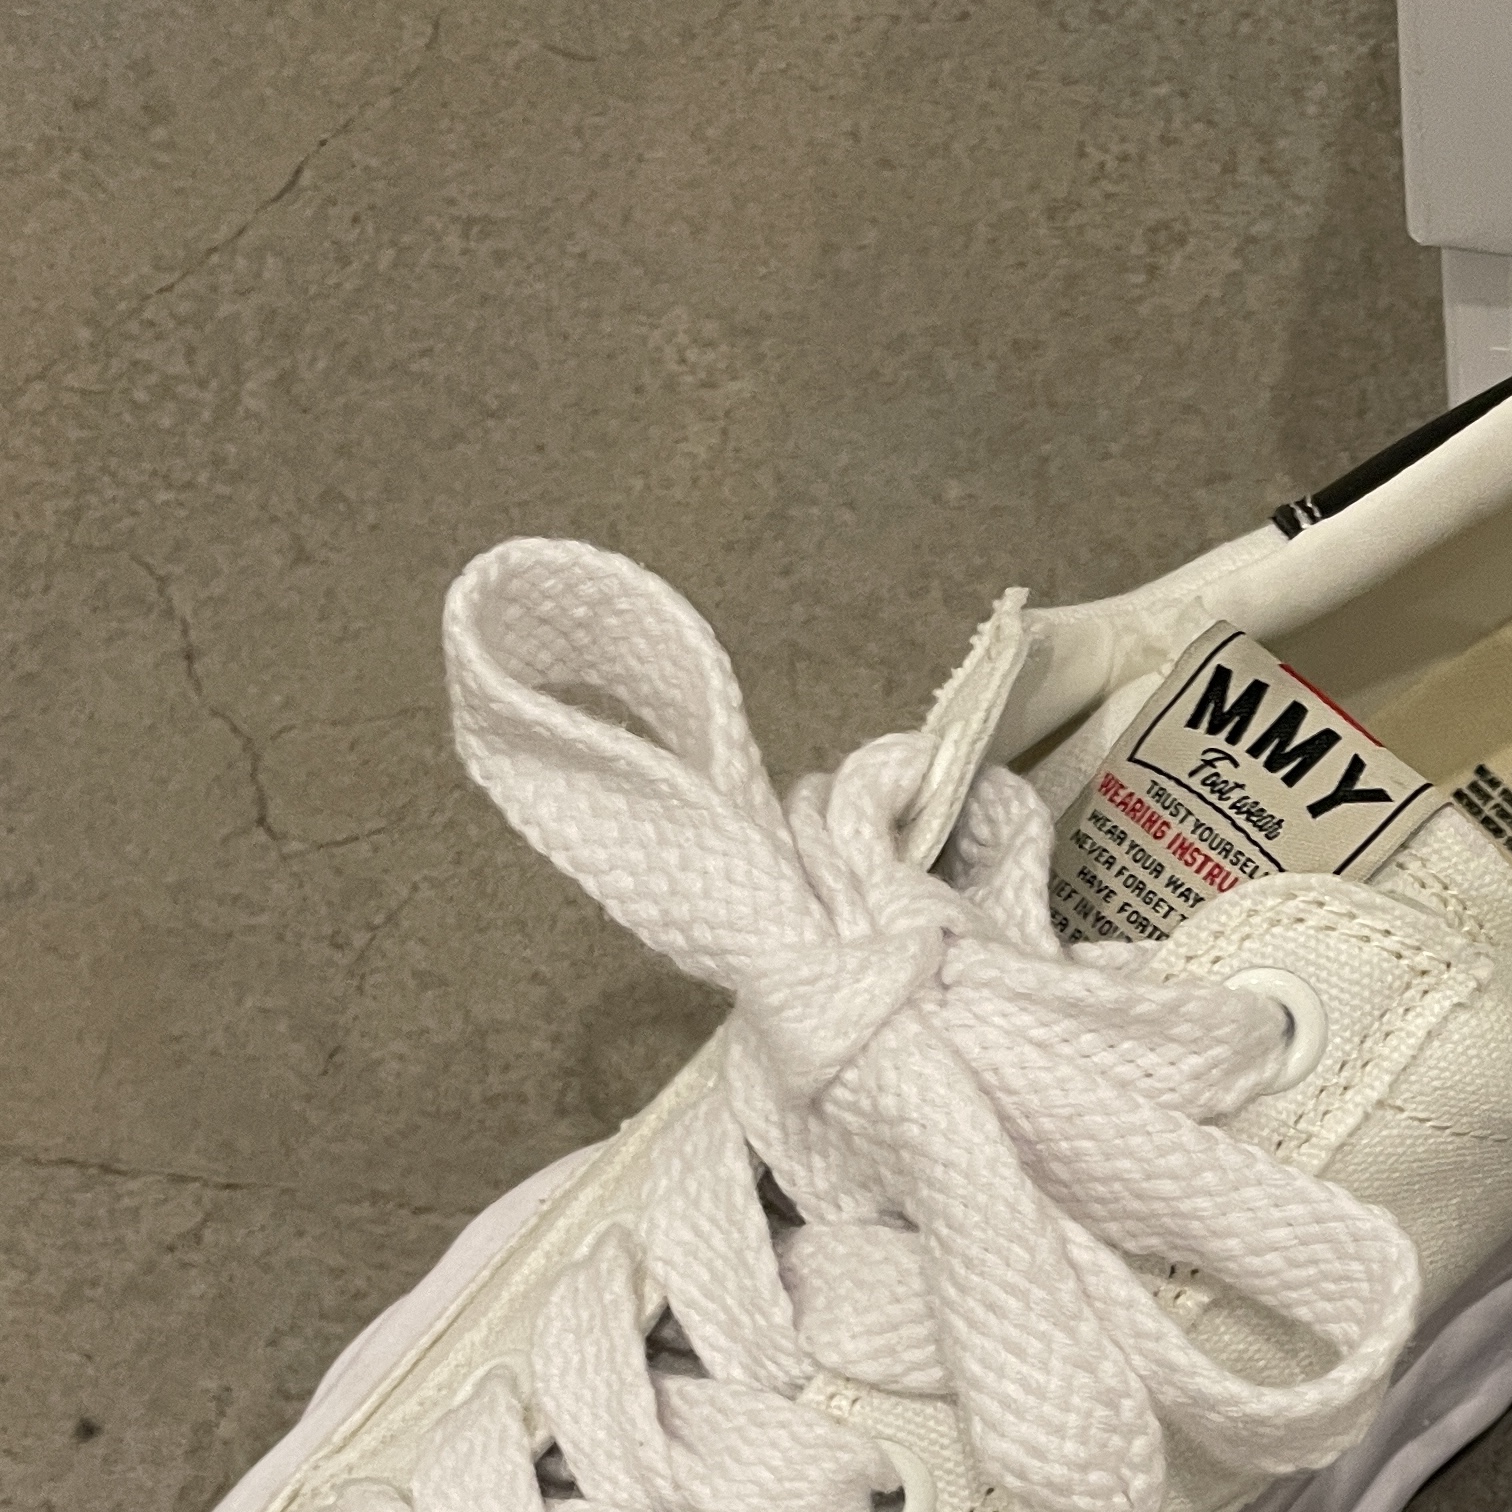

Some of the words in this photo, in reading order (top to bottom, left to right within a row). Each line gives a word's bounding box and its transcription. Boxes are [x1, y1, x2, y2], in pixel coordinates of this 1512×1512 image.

[1183, 663, 1395, 819] MMY
[1069, 828, 1117, 871] NEVER
[1114, 865, 1178, 920] FORGET
[1087, 808, 1129, 847] WEAR
[1124, 839, 1166, 880] YOUR
[1164, 874, 1206, 909] WAY
[1097, 771, 1172, 841] WEARING
[1165, 831, 1240, 894] INSTRU
[1144, 779, 1198, 825] TRUST
[1190, 818, 1270, 880] YOURSEL
[1077, 864, 1118, 904] HAVE
